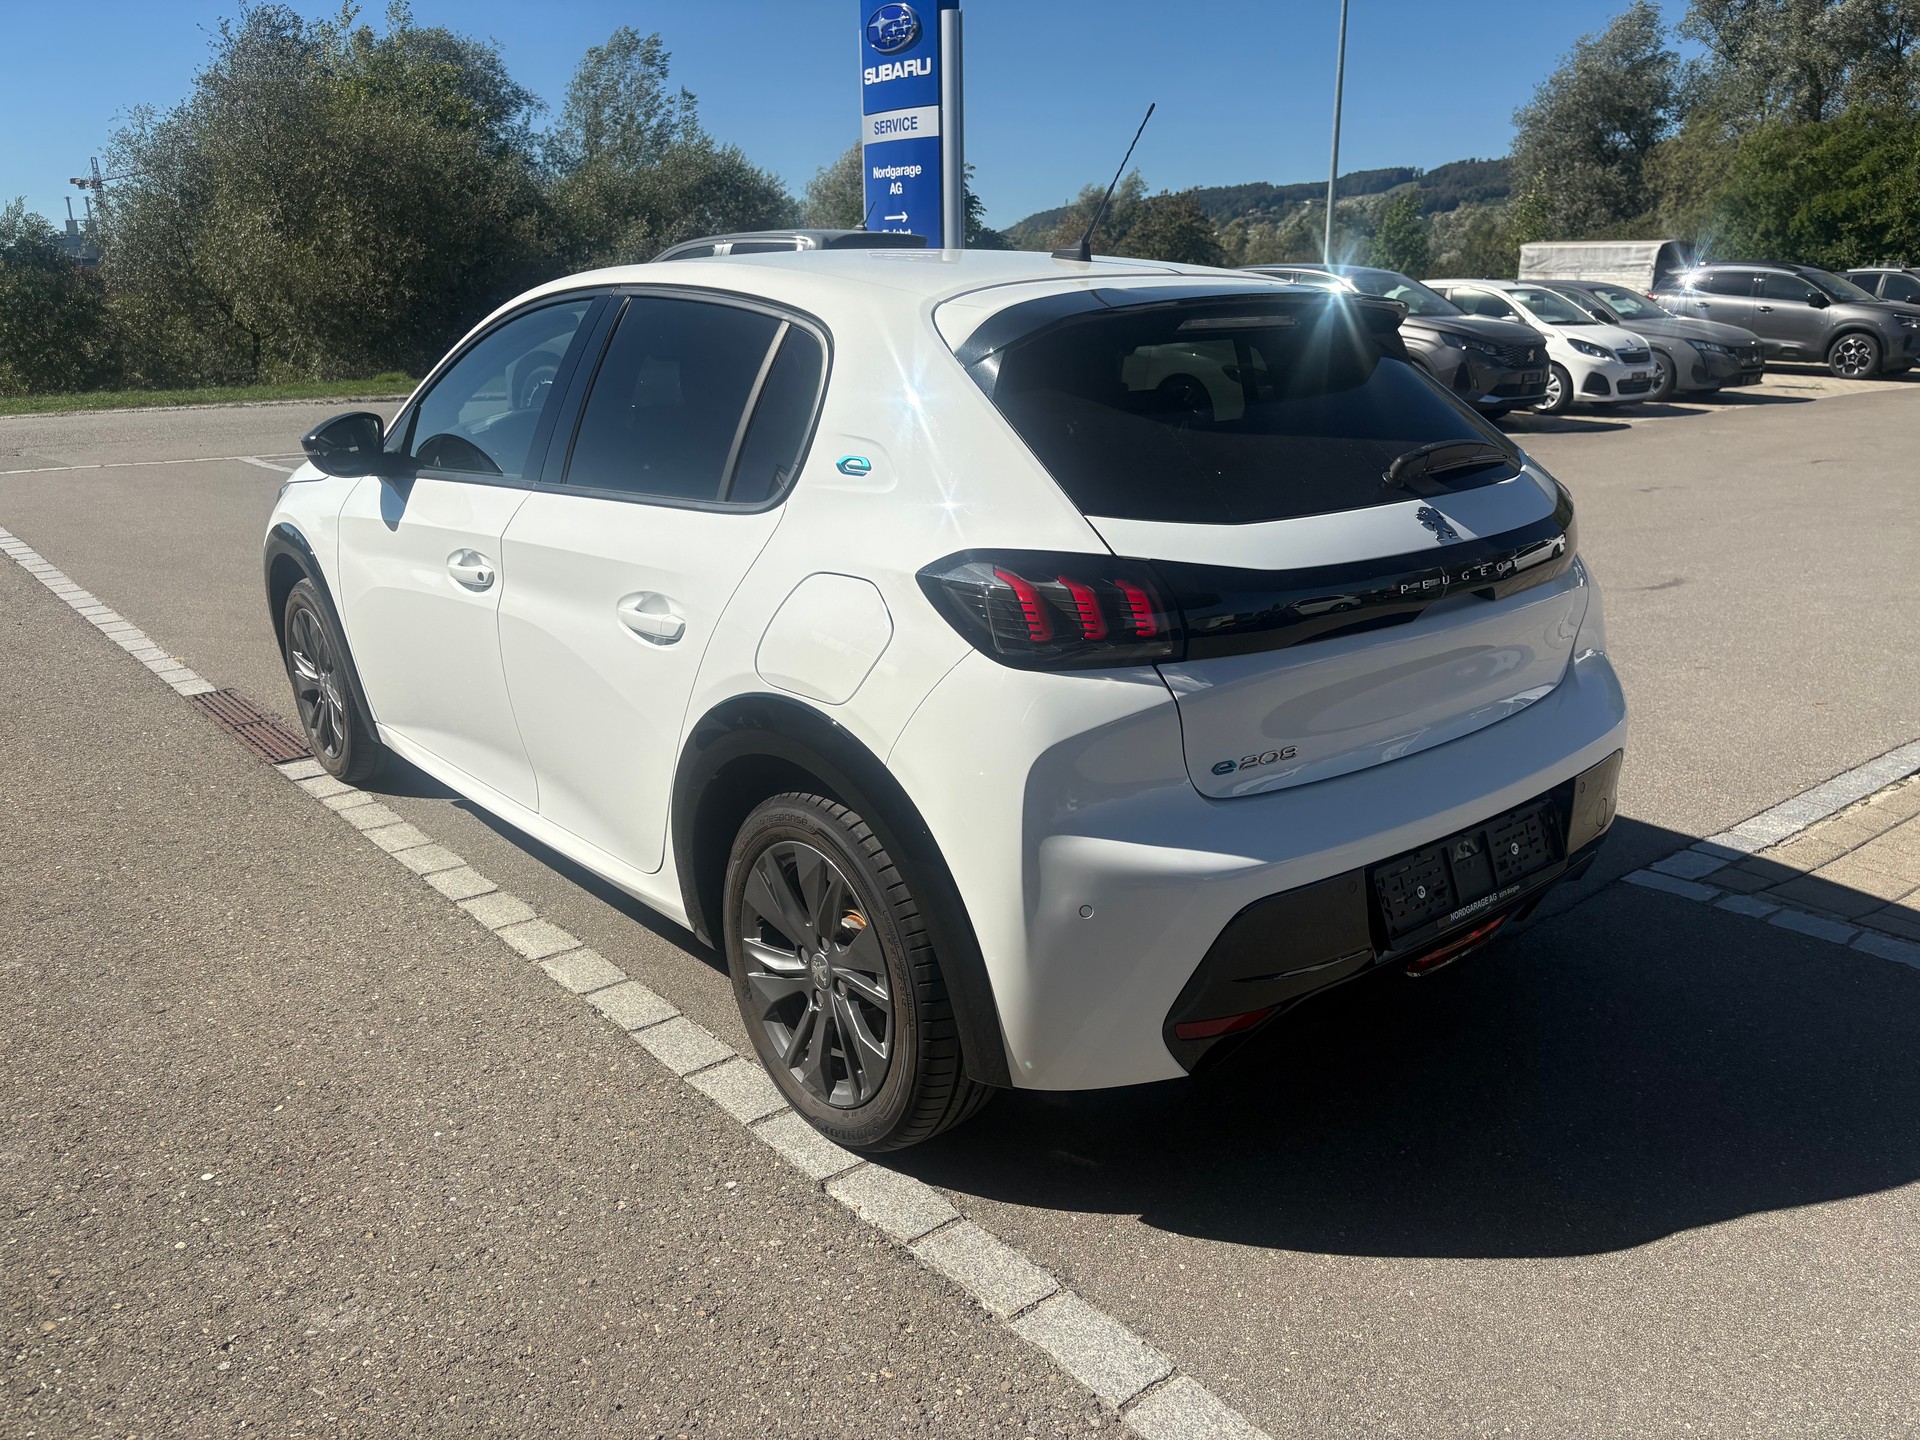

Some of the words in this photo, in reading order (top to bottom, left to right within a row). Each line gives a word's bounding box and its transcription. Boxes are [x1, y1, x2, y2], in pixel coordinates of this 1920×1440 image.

[864, 57, 932, 86] SUBARU
[874, 116, 918, 135] SERVICE
[872, 165, 922, 179] Nordgarage
[889, 182, 903, 195] AG
[1400, 559, 1518, 594] PEUGEOT
[1450, 896, 1489, 922] NORDGARAGE
[1489, 892, 1498, 904] AG
